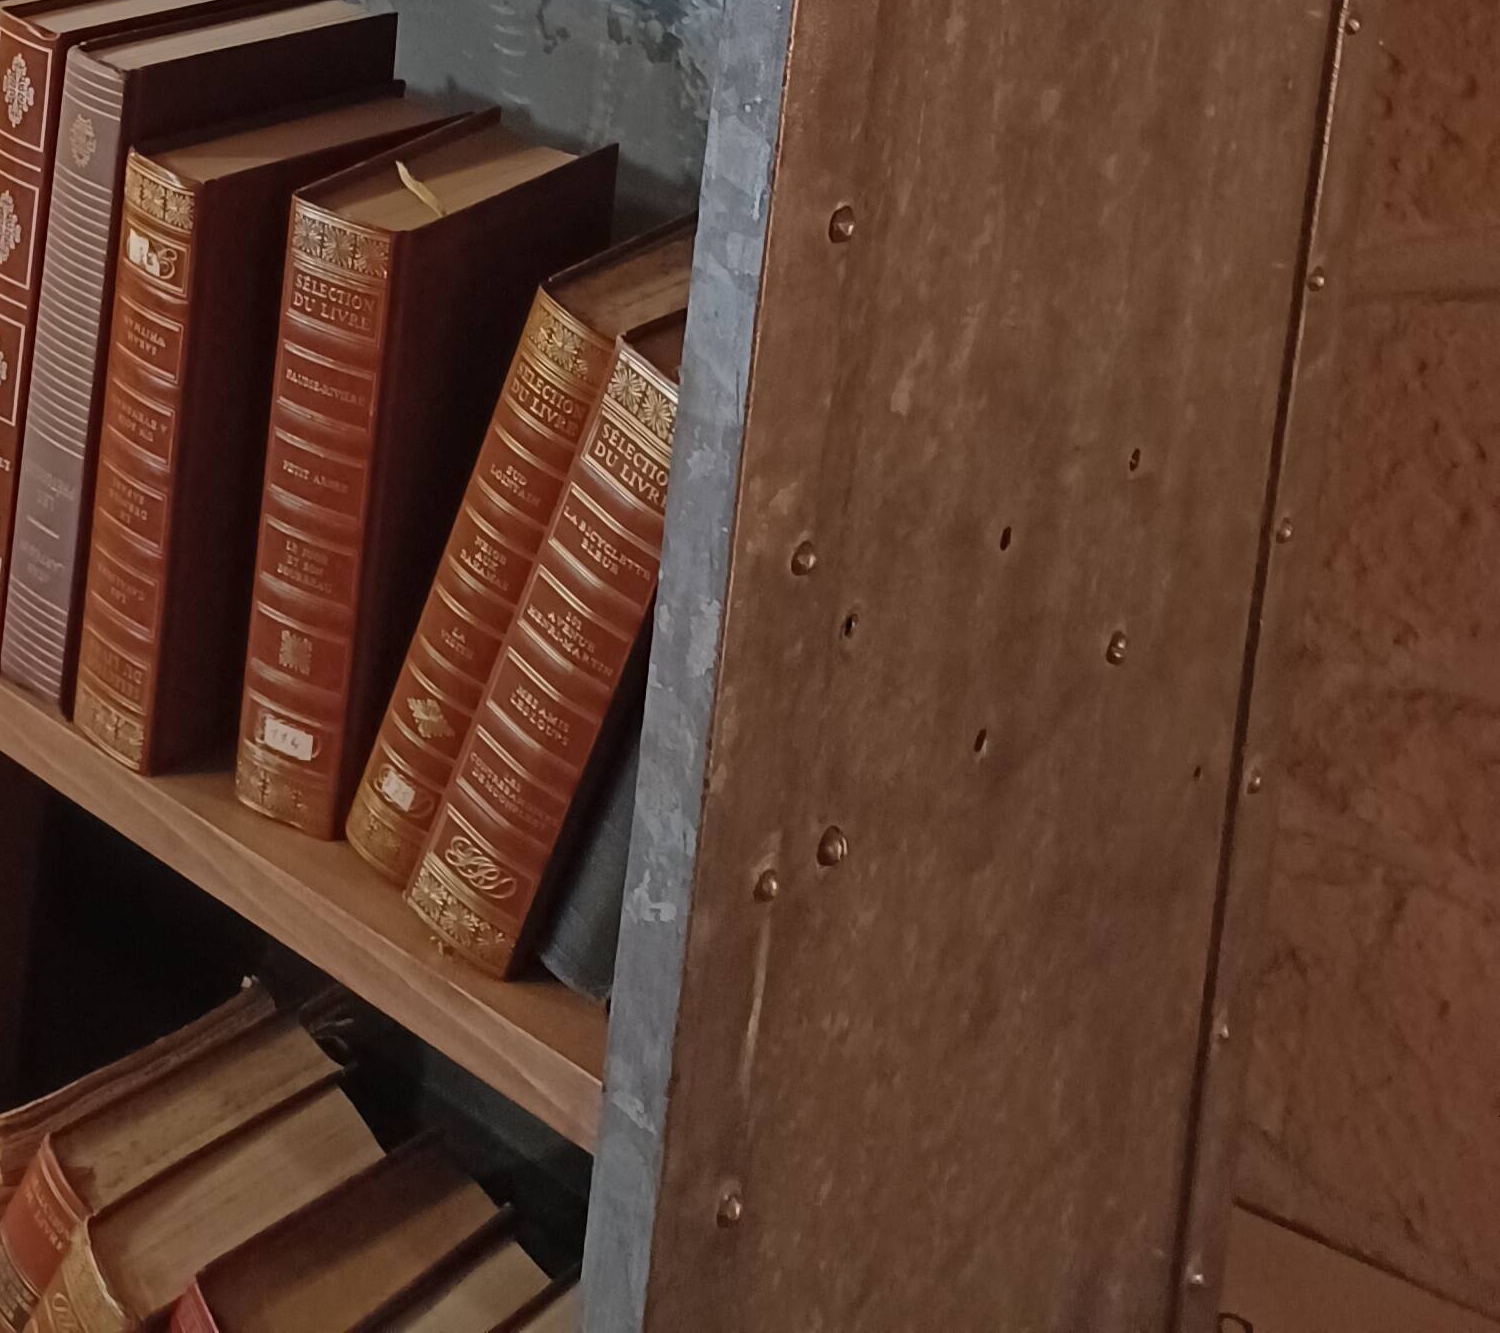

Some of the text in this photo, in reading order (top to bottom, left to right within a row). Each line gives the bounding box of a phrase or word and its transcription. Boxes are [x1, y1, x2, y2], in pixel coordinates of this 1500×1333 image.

[293, 292, 372, 331] DU LIVRE
[295, 274, 375, 313] SÉLECTION
[511, 378, 530, 402] DU
[595, 440, 619, 467] DU
[601, 423, 670, 487] SÉLECTIO
[506, 465, 528, 487] SUD
[564, 506, 652, 582] LA BICYCLETTE
[580, 539, 620, 576] BLEUE
